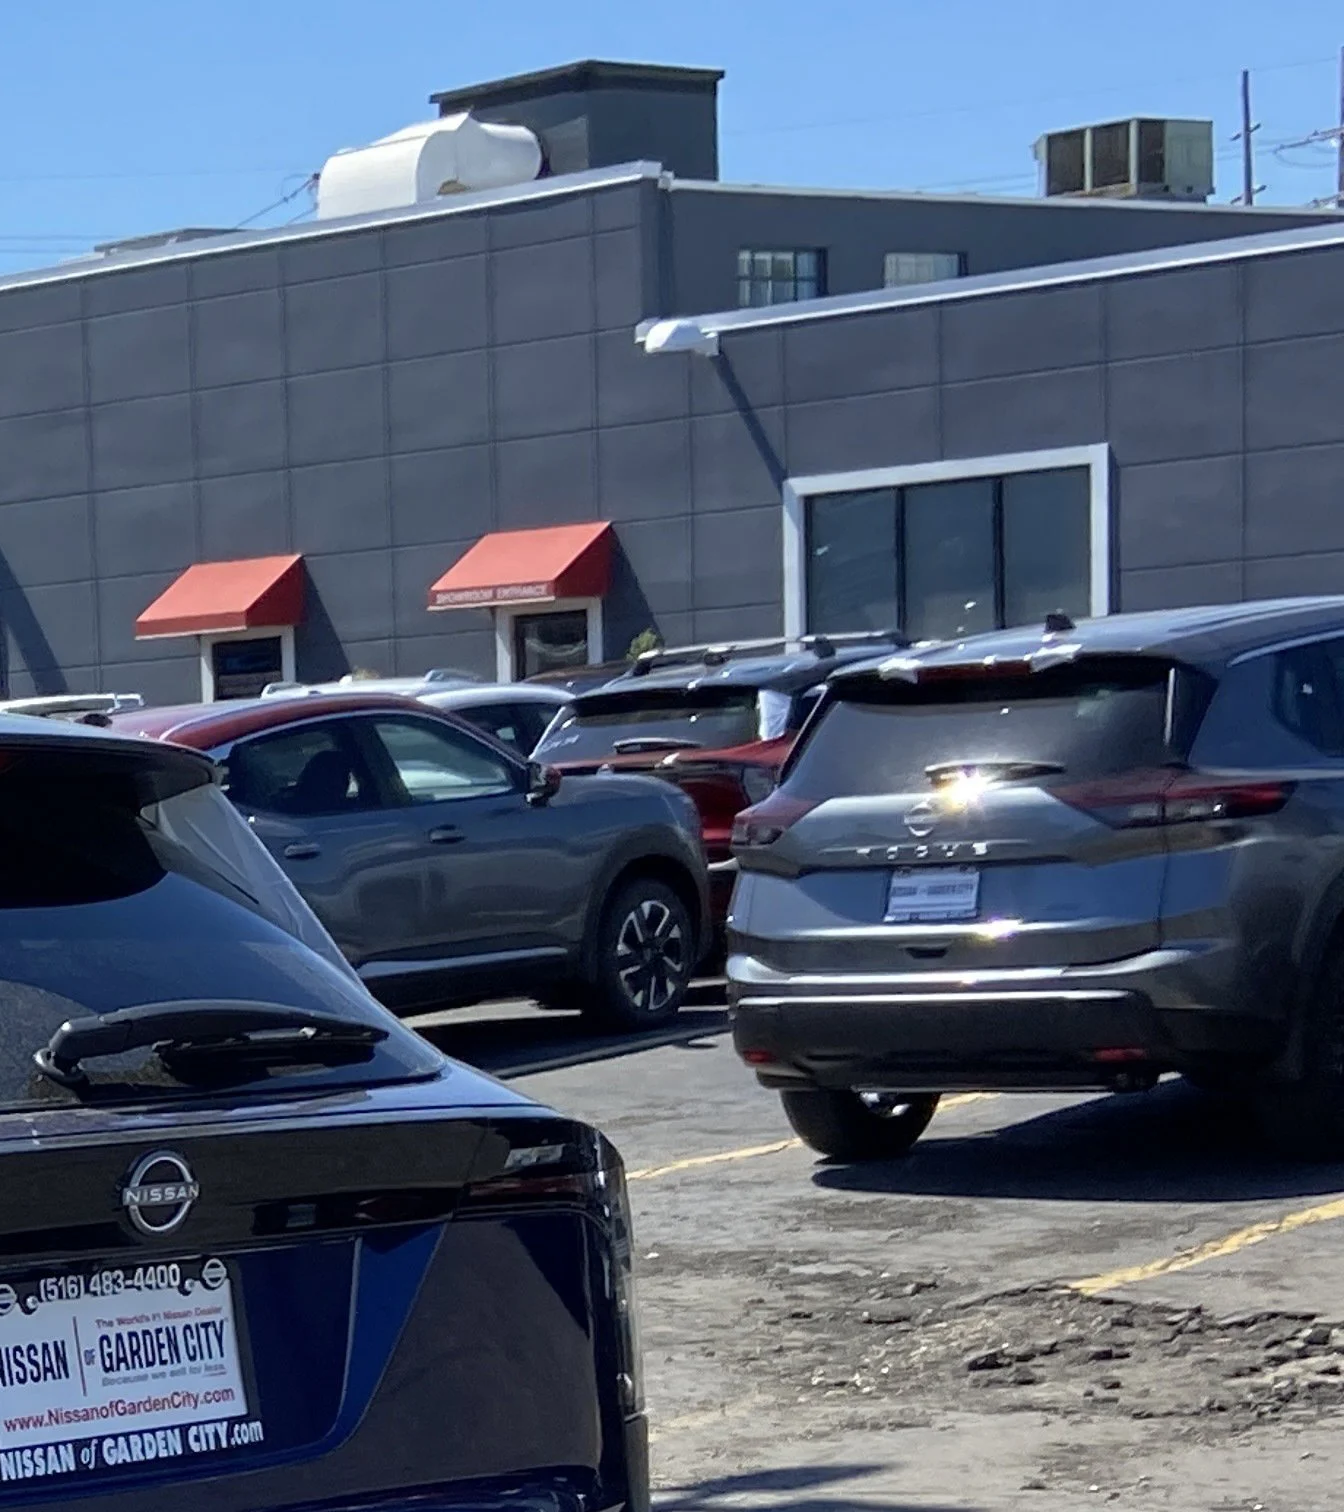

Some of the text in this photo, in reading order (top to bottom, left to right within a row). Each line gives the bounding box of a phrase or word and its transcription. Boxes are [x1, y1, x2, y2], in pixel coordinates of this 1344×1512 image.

[125, 1183, 200, 1204] NISSAN
[39, 1263, 181, 1302] (516) 483-4400
[98, 1324, 182, 1374] GARDEN
[182, 1319, 225, 1362] CITY
[3, 1387, 236, 1433] www.NissanofGardenCity.com
[80, 1437, 100, 1470] of
[101, 1427, 184, 1466] GARDEN
[187, 1419, 265, 1454] CITY.com
